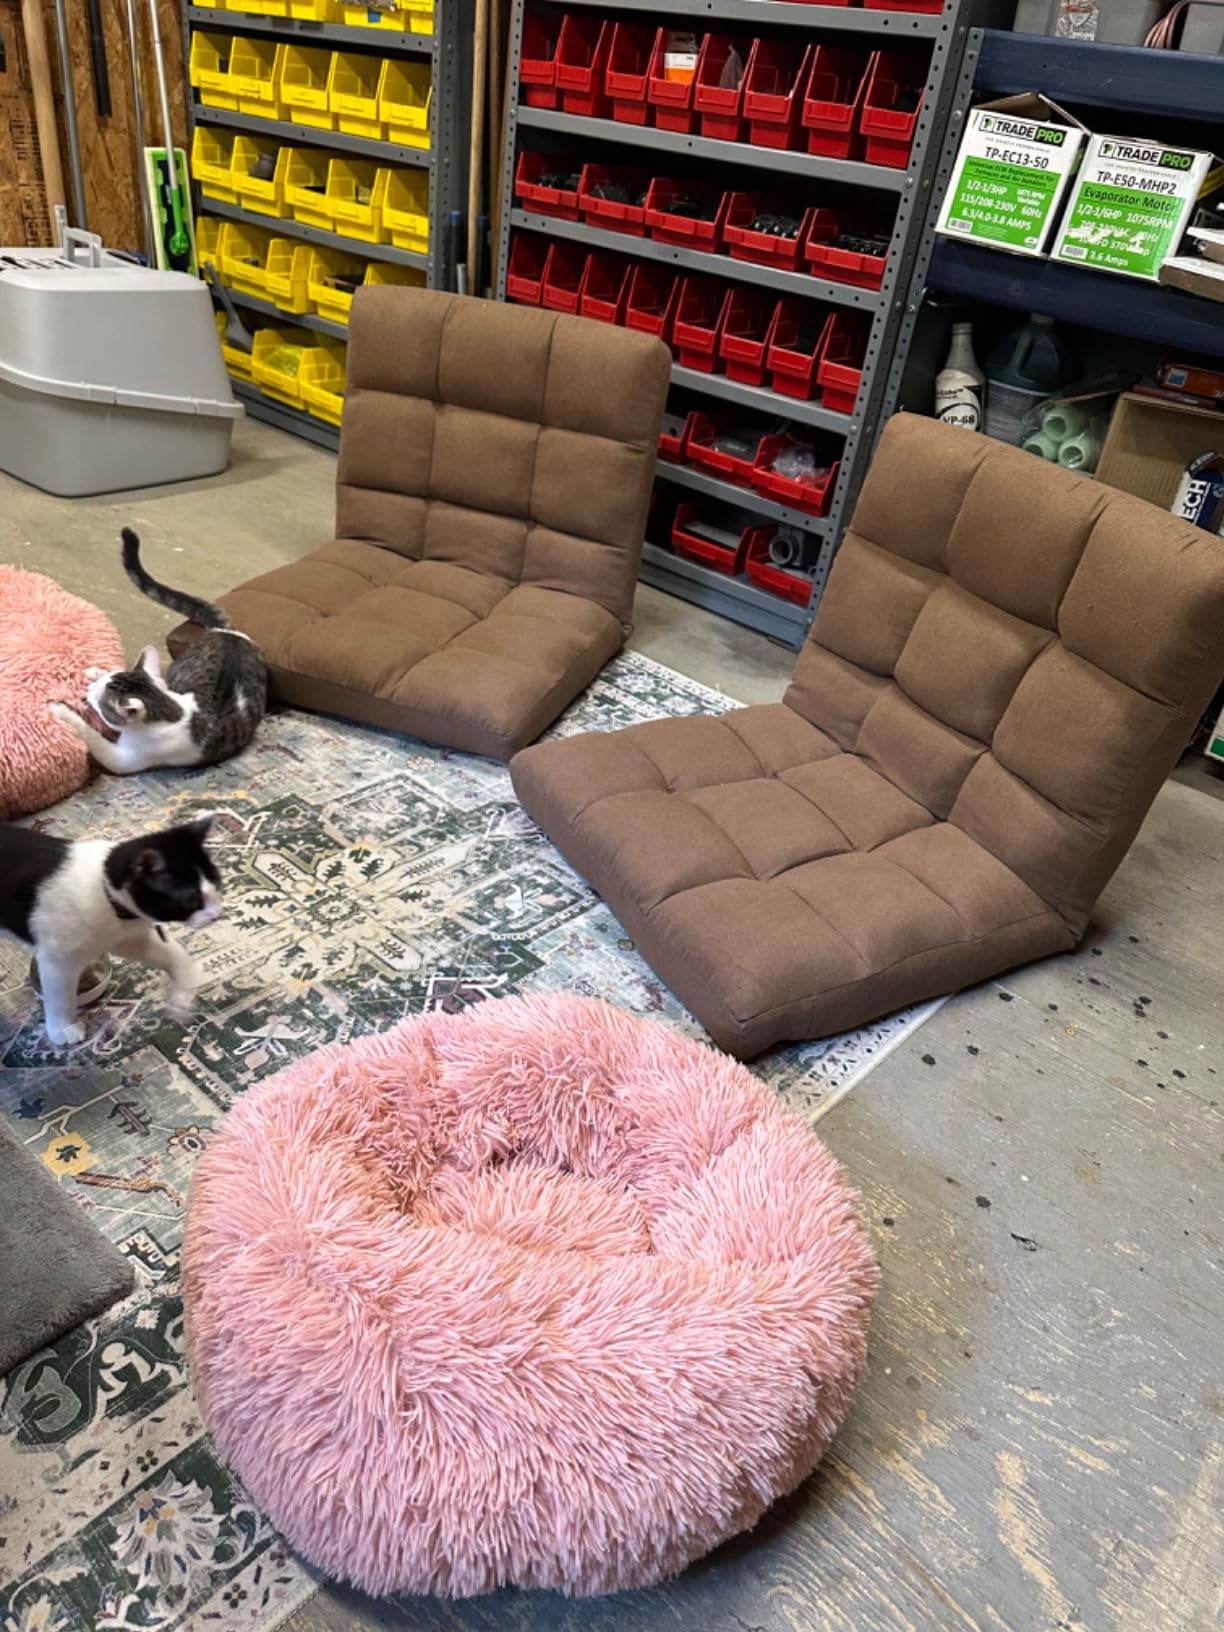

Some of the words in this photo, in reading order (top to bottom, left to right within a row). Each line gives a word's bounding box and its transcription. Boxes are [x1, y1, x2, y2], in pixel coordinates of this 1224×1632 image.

[985, 146, 1049, 169] TP-EC13-50
[1096, 171, 1177, 195] TP-E50-MHP2
[1083, 187, 1140, 206] Evaporator
[1006, 217, 1032, 231] AMPS
[1077, 203, 1122, 220] 1/2-1/6HP
[1126, 212, 1173, 229] 1075RPM
[1105, 253, 1129, 266] Amps
